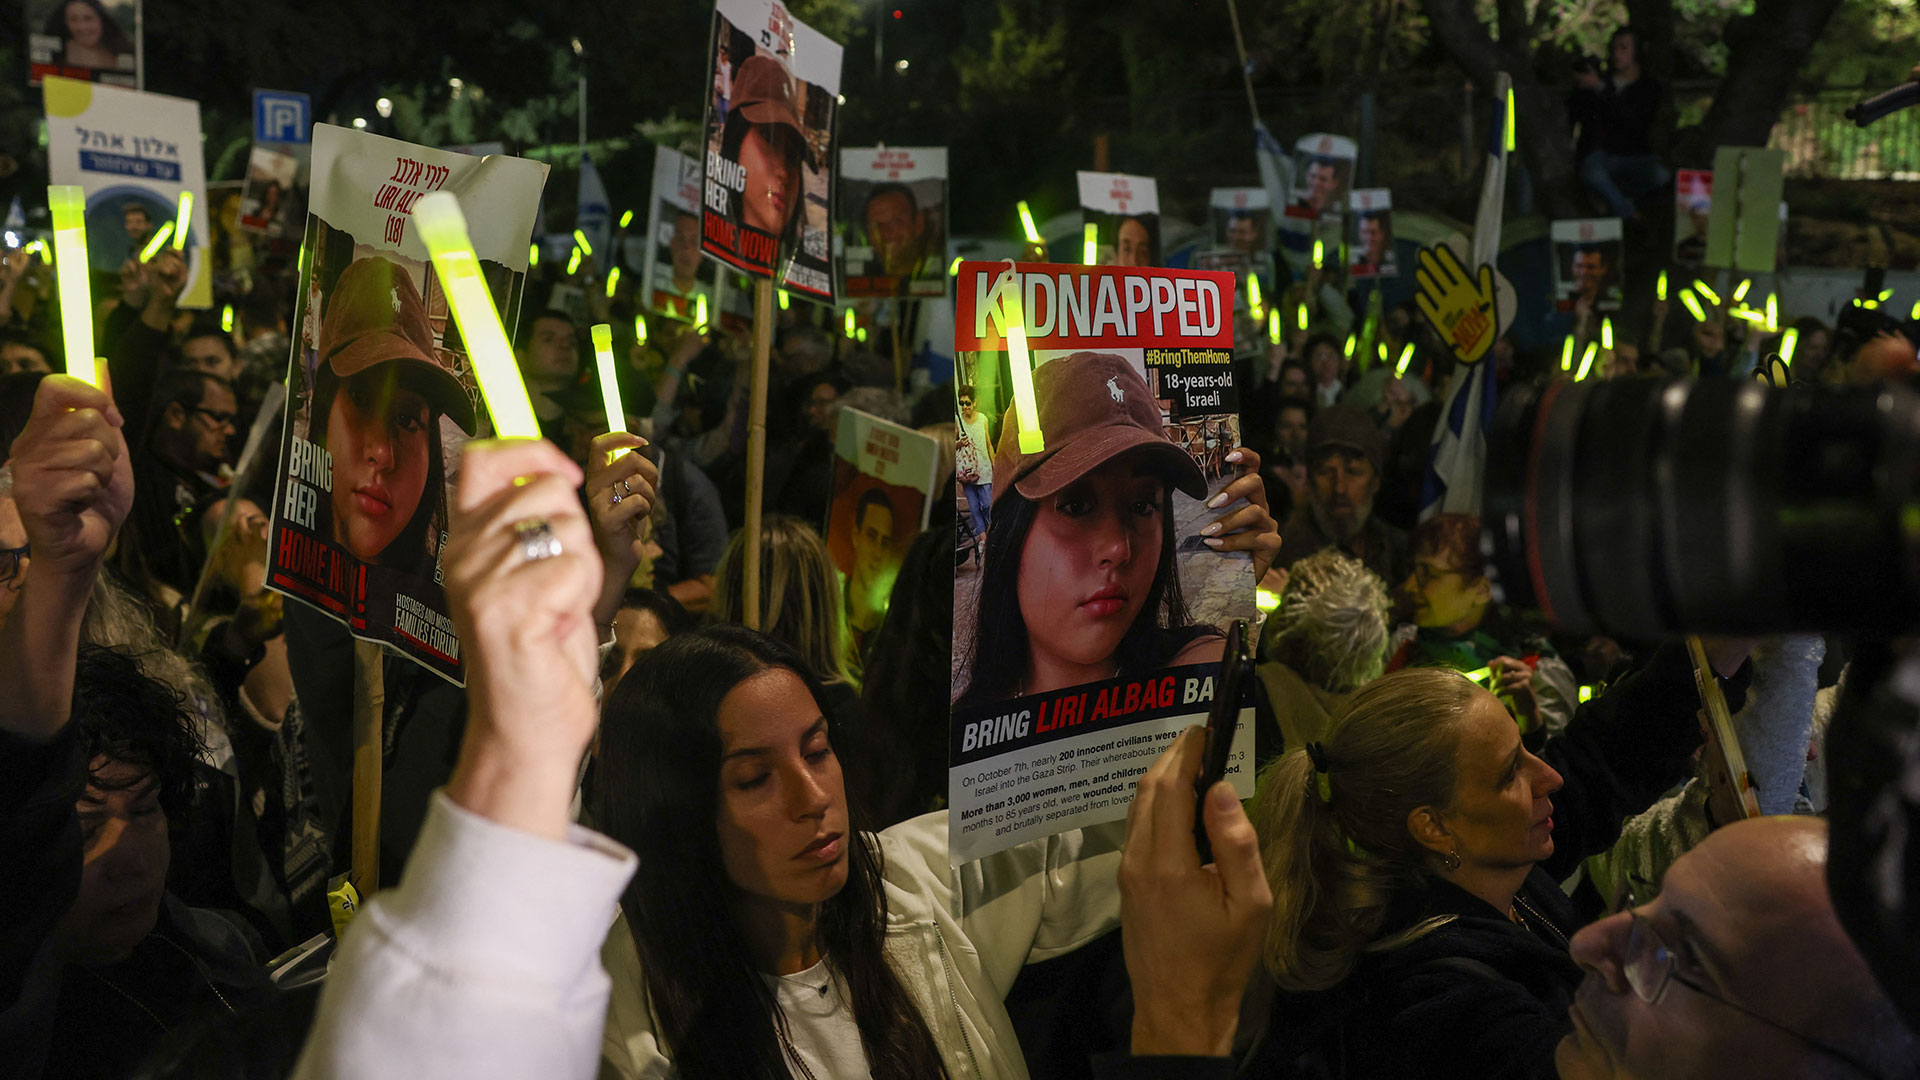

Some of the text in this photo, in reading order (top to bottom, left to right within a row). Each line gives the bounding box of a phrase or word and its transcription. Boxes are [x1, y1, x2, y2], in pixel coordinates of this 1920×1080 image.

[75, 126, 179, 159] אלון אהל
[389, 157, 450, 191] לירי אלבג
[705, 150, 747, 193] BRING
[374, 184, 402, 210] LIRI
[705, 178, 729, 216] HER
[384, 214, 406, 247] (18)
[705, 210, 779, 268] HOME NOW!
[974, 271, 1223, 338] KDNAPPED
[1146, 349, 1231, 368] #BringThemHome
[1165, 371, 1233, 392] 18-years-old
[1185, 390, 1221, 407] Israeli
[288, 435, 334, 493] BRING
[283, 479, 318, 531] HER
[277, 527, 369, 613] HOME NOW!
[396, 593, 426, 619] HOSTAGES
[424, 607, 436, 625] AND
[395, 607, 459, 660] FAMILIES FORUM
[961, 709, 1031, 753] BRING
[1036, 693, 1088, 734] LIRI
[1090, 676, 1176, 722] ALBAG
[962, 777, 976, 788] On
[977, 767, 1012, 783] October
[1014, 762, 1029, 774] 7th,
[1031, 754, 1057, 768] nearly
[1059, 749, 1075, 762] 200
[1077, 741, 1115, 757] innocent
[1116, 734, 1153, 749] civilians
[1154, 730, 1178, 742] were
[974, 782, 998, 798] Israel
[1000, 779, 1016, 791] into
[1017, 774, 1031, 786] the
[1032, 768, 1055, 781] Gaza
[1056, 763, 1078, 777] Strip.
[1081, 757, 1101, 769] Their
[1103, 746, 1156, 764] whereabouts
[961, 807, 984, 821] More
[985, 801, 1006, 813] than
[1007, 792, 1031, 807] 3,000
[1032, 785, 1067, 800] women,
[1068, 778, 1091, 791] men,
[1092, 772, 1110, 785] and
[1111, 766, 1148, 781] children
[962, 816, 994, 834] months
[994, 814, 1004, 824] to
[1005, 810, 1017, 820] 85
[1018, 803, 1041, 819] years
[1060, 792, 1081, 804] were
[995, 793, 1136, 837] and brutally separated from loved
